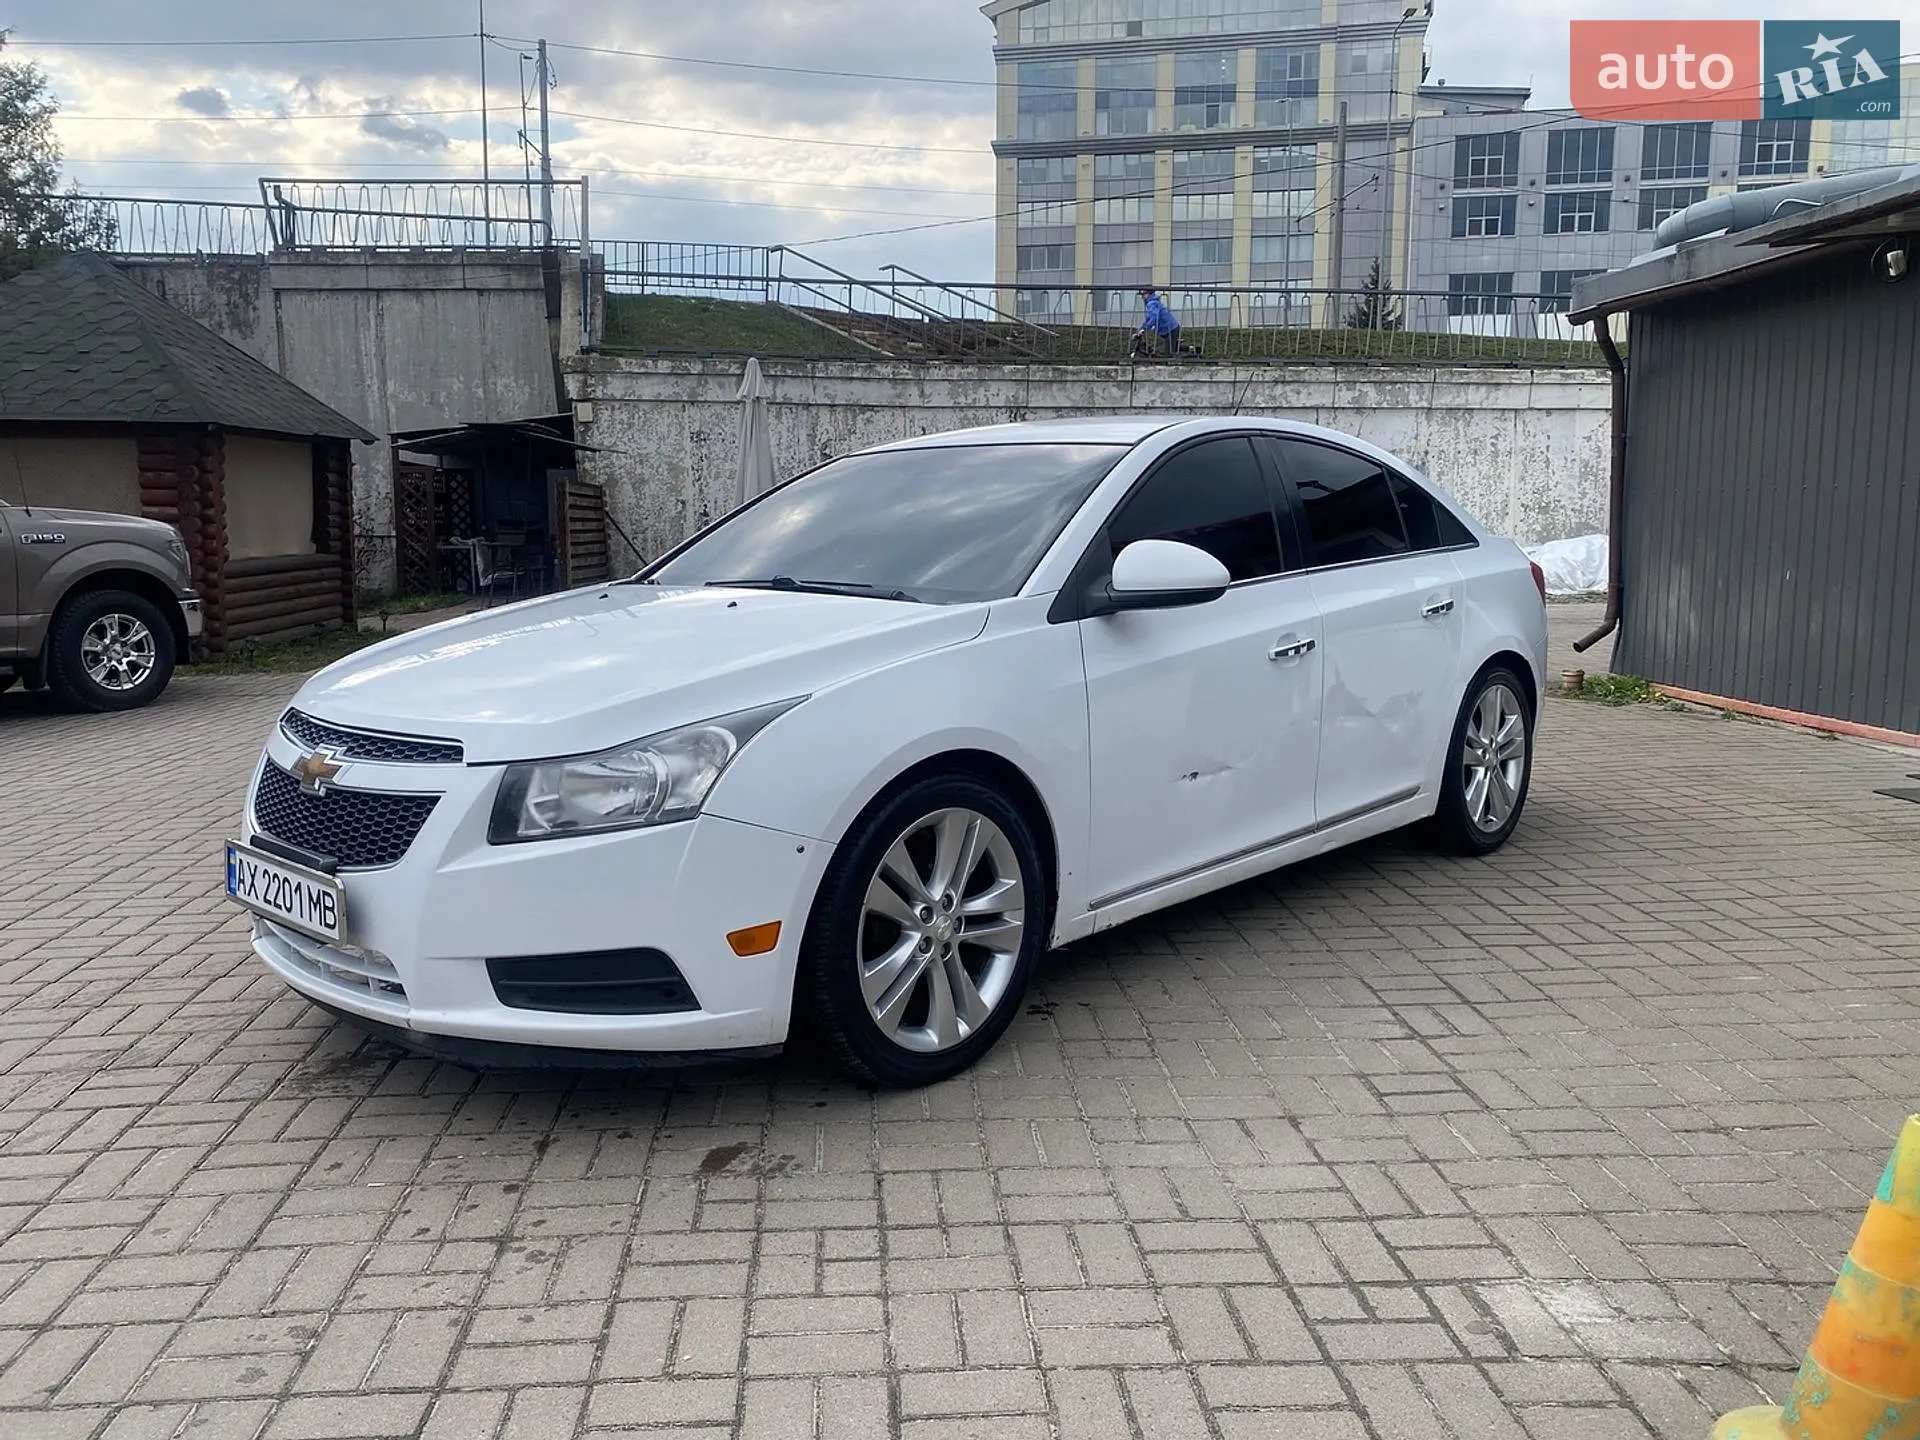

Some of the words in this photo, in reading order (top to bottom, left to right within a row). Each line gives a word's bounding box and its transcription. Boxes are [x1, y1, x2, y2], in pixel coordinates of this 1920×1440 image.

[237, 858, 259, 900] AX
[262, 868, 303, 918] 2201
[307, 884, 337, 930] MB
